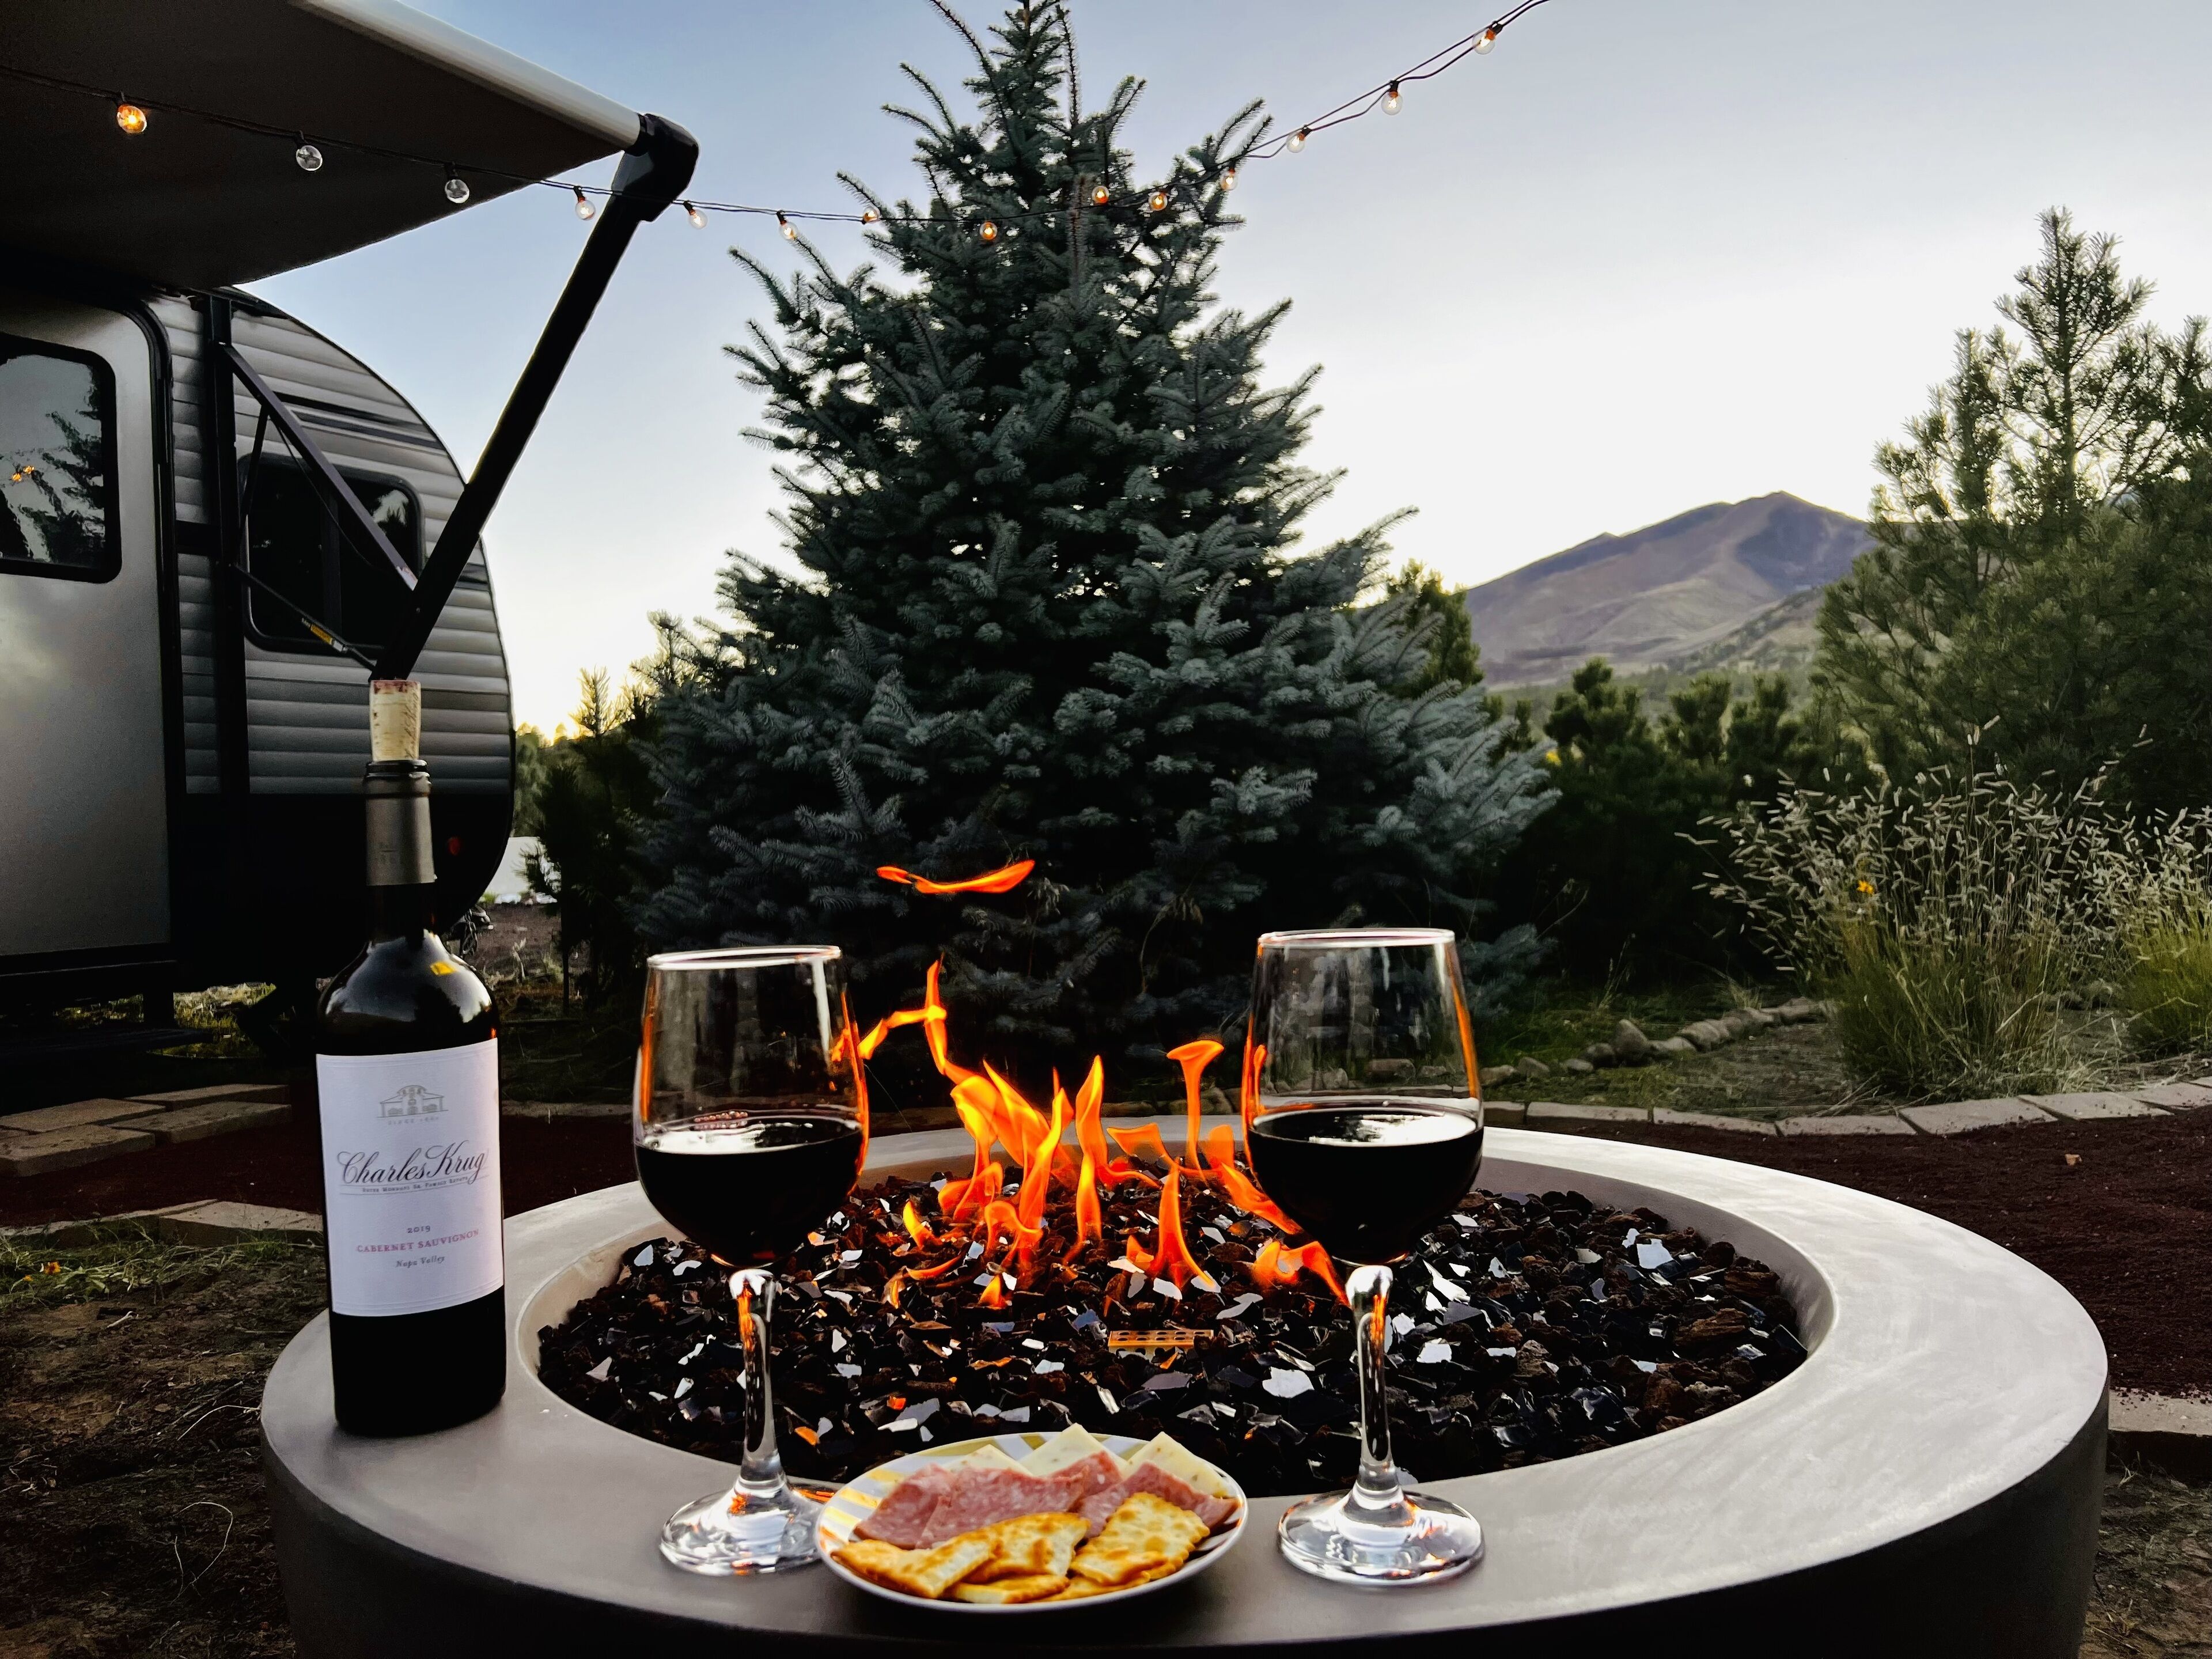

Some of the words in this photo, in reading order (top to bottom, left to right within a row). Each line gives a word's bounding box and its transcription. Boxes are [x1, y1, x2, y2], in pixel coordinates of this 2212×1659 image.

[336, 1147, 427, 1184] Charles
[425, 1139, 489, 1184] Krug
[357, 1243, 415, 1252] CABERNET
[418, 1230, 479, 1249] SAUVIGNON
